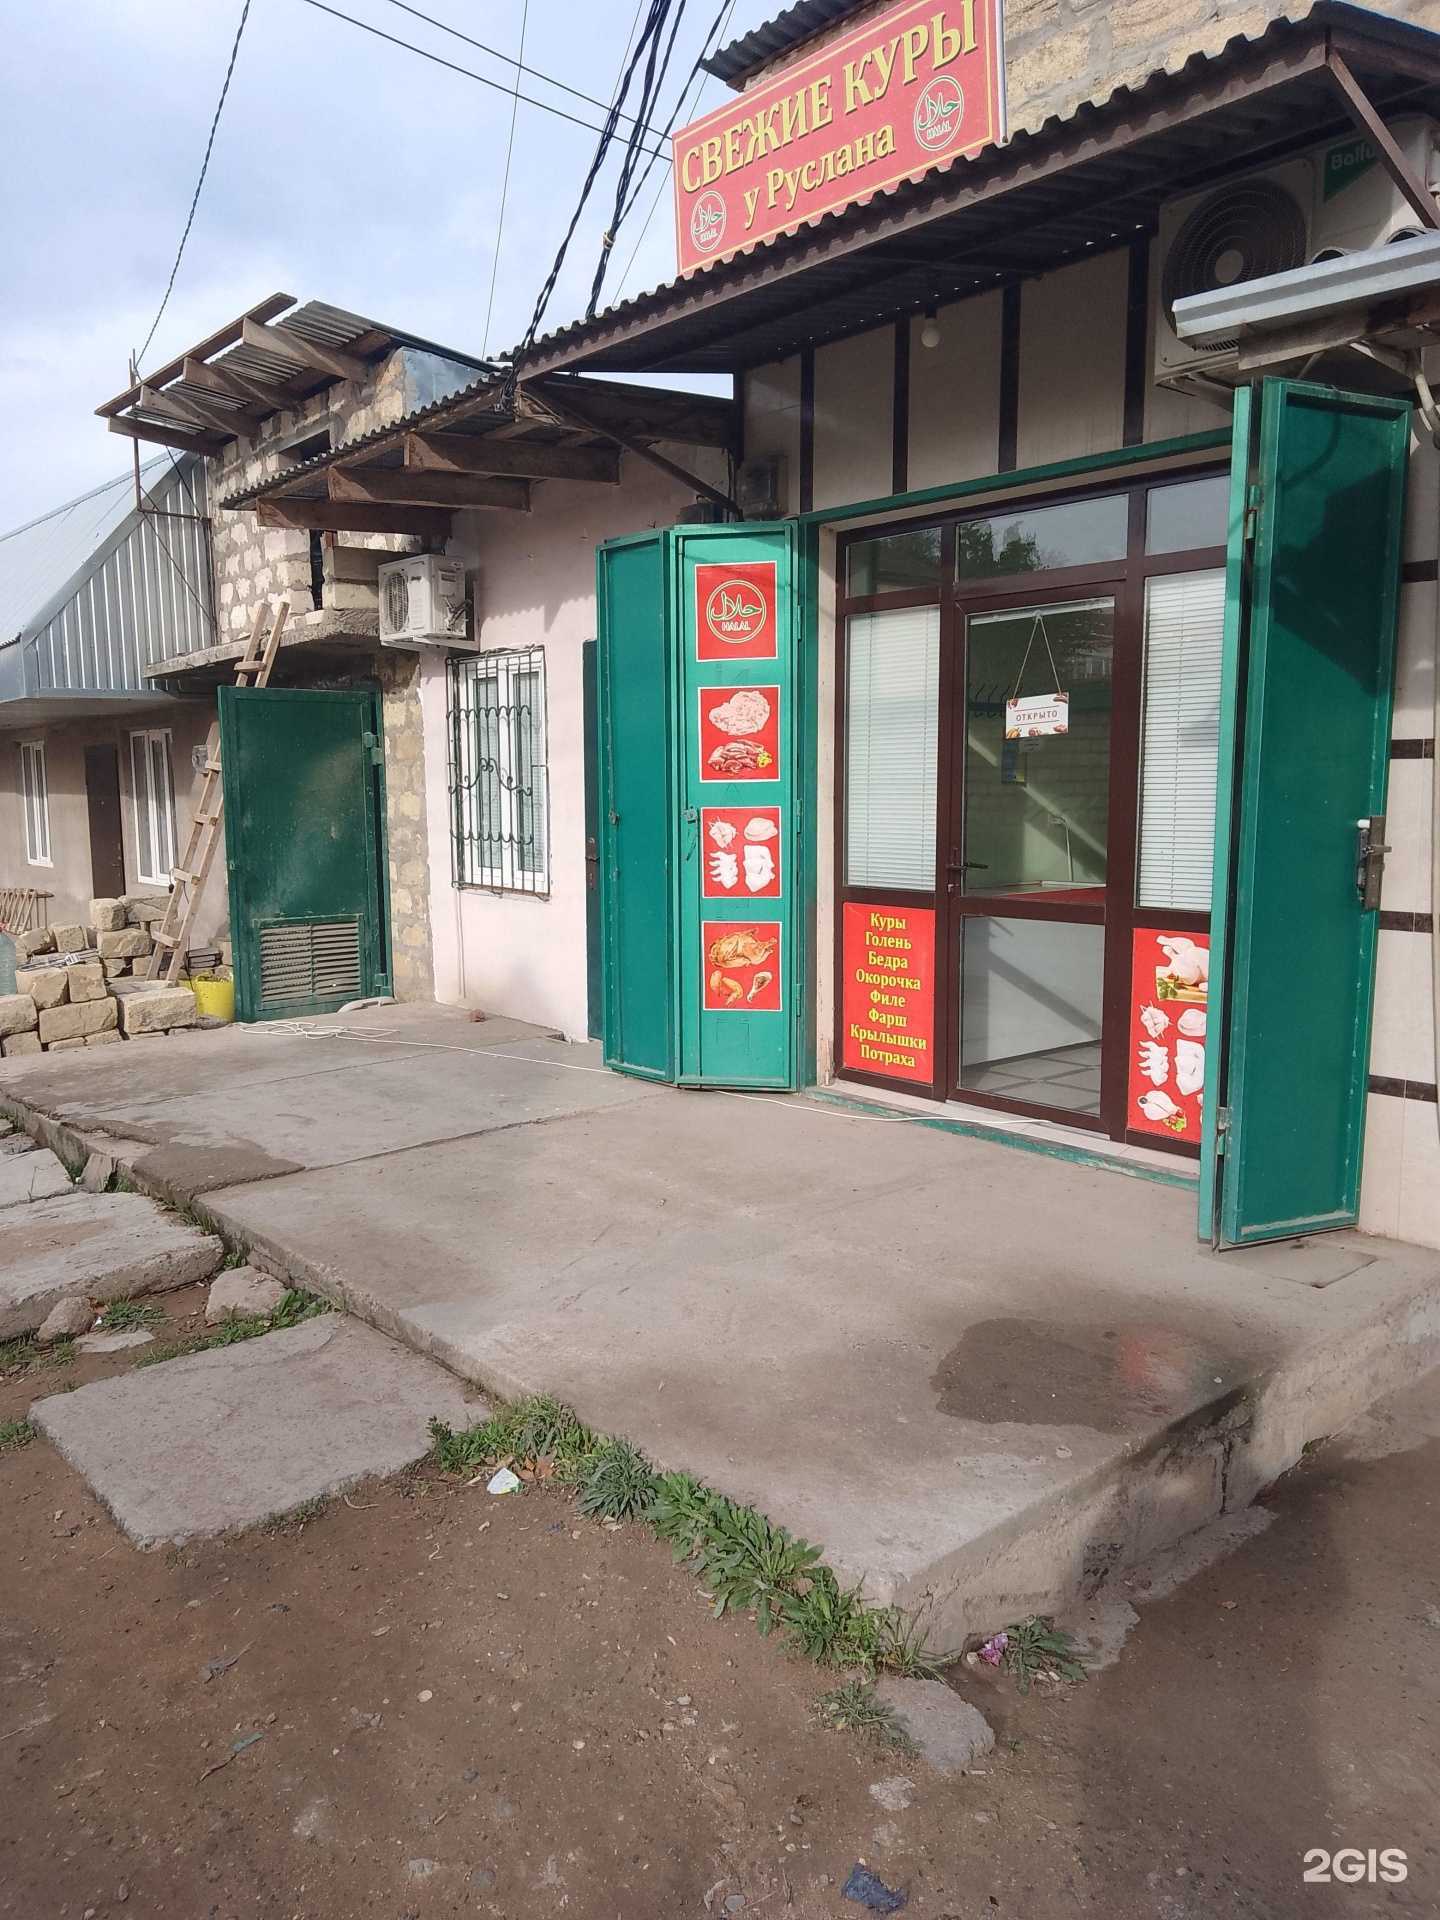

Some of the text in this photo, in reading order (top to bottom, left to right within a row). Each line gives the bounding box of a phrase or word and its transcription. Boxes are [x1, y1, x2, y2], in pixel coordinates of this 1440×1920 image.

[682, 0, 979, 194] СВЕЖИЕ КУРЫ
[743, 124, 897, 230] у Руслана
[711, 590, 763, 621] حلال
[721, 619, 752, 632] HALAL
[1015, 710, 1058, 722] ОТКРЫТО
[870, 912, 906, 931] Куры
[864, 931, 912, 950] Голень
[868, 951, 908, 970] Бедра
[855, 968, 921, 991] Окорочка
[870, 989, 906, 1008] Филе
[868, 1007, 907, 1027] Фарш
[850, 1024, 927, 1050] Крылышки
[860, 1044, 916, 1068] Потраха
